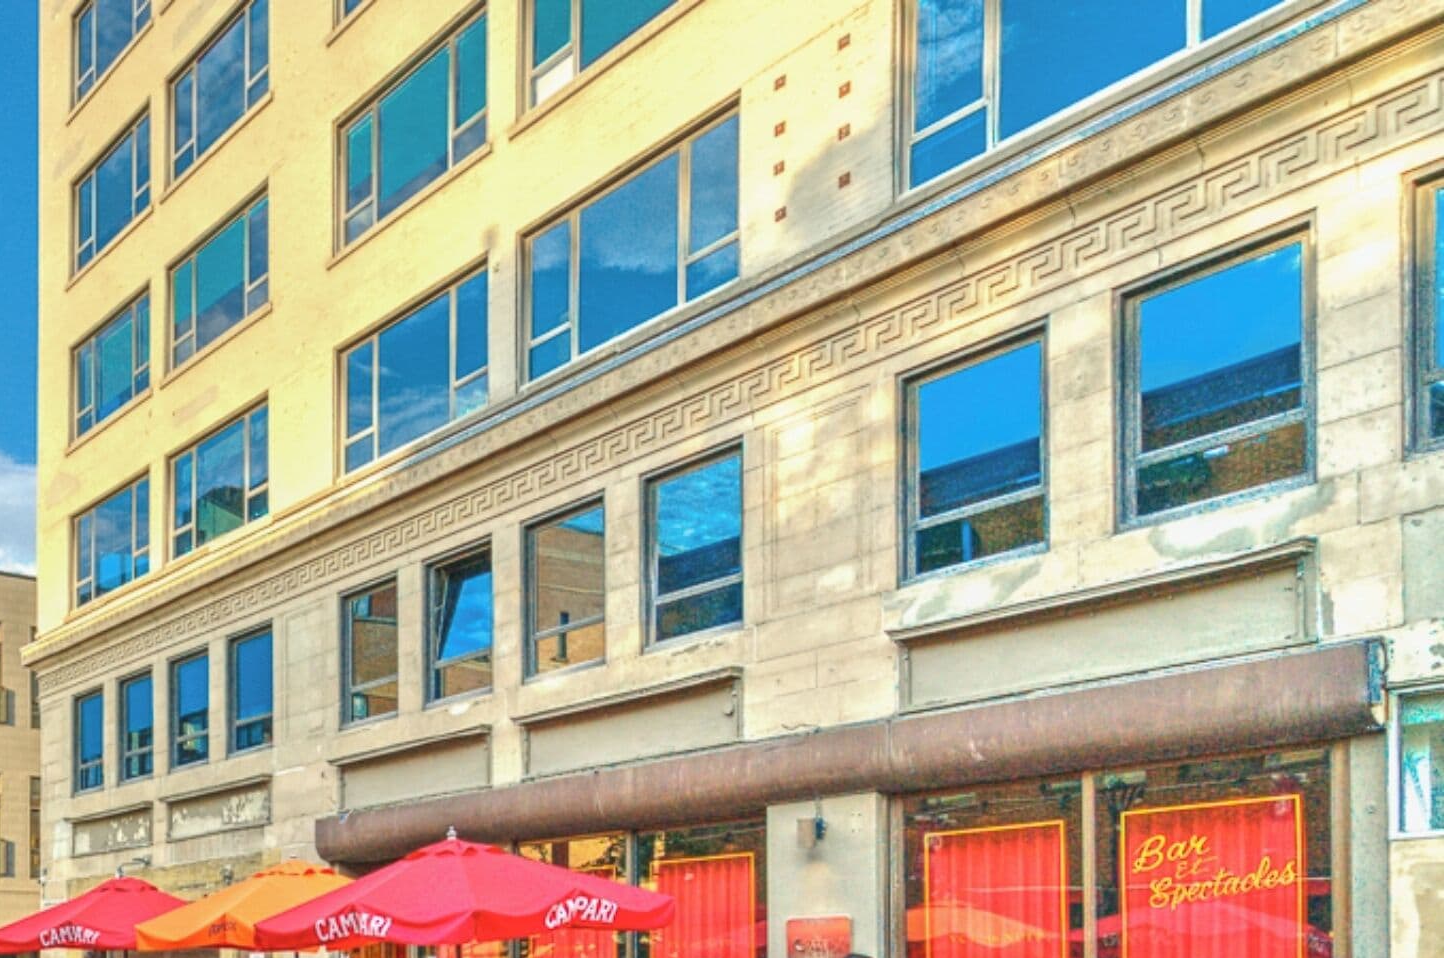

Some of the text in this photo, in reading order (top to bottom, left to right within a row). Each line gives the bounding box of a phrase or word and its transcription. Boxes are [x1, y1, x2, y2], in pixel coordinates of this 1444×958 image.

[1132, 834, 1210, 874] Bar
[1149, 855, 1297, 912] Spectacles
[315, 911, 393, 942] CAMARI
[545, 895, 618, 930] CAMPARI
